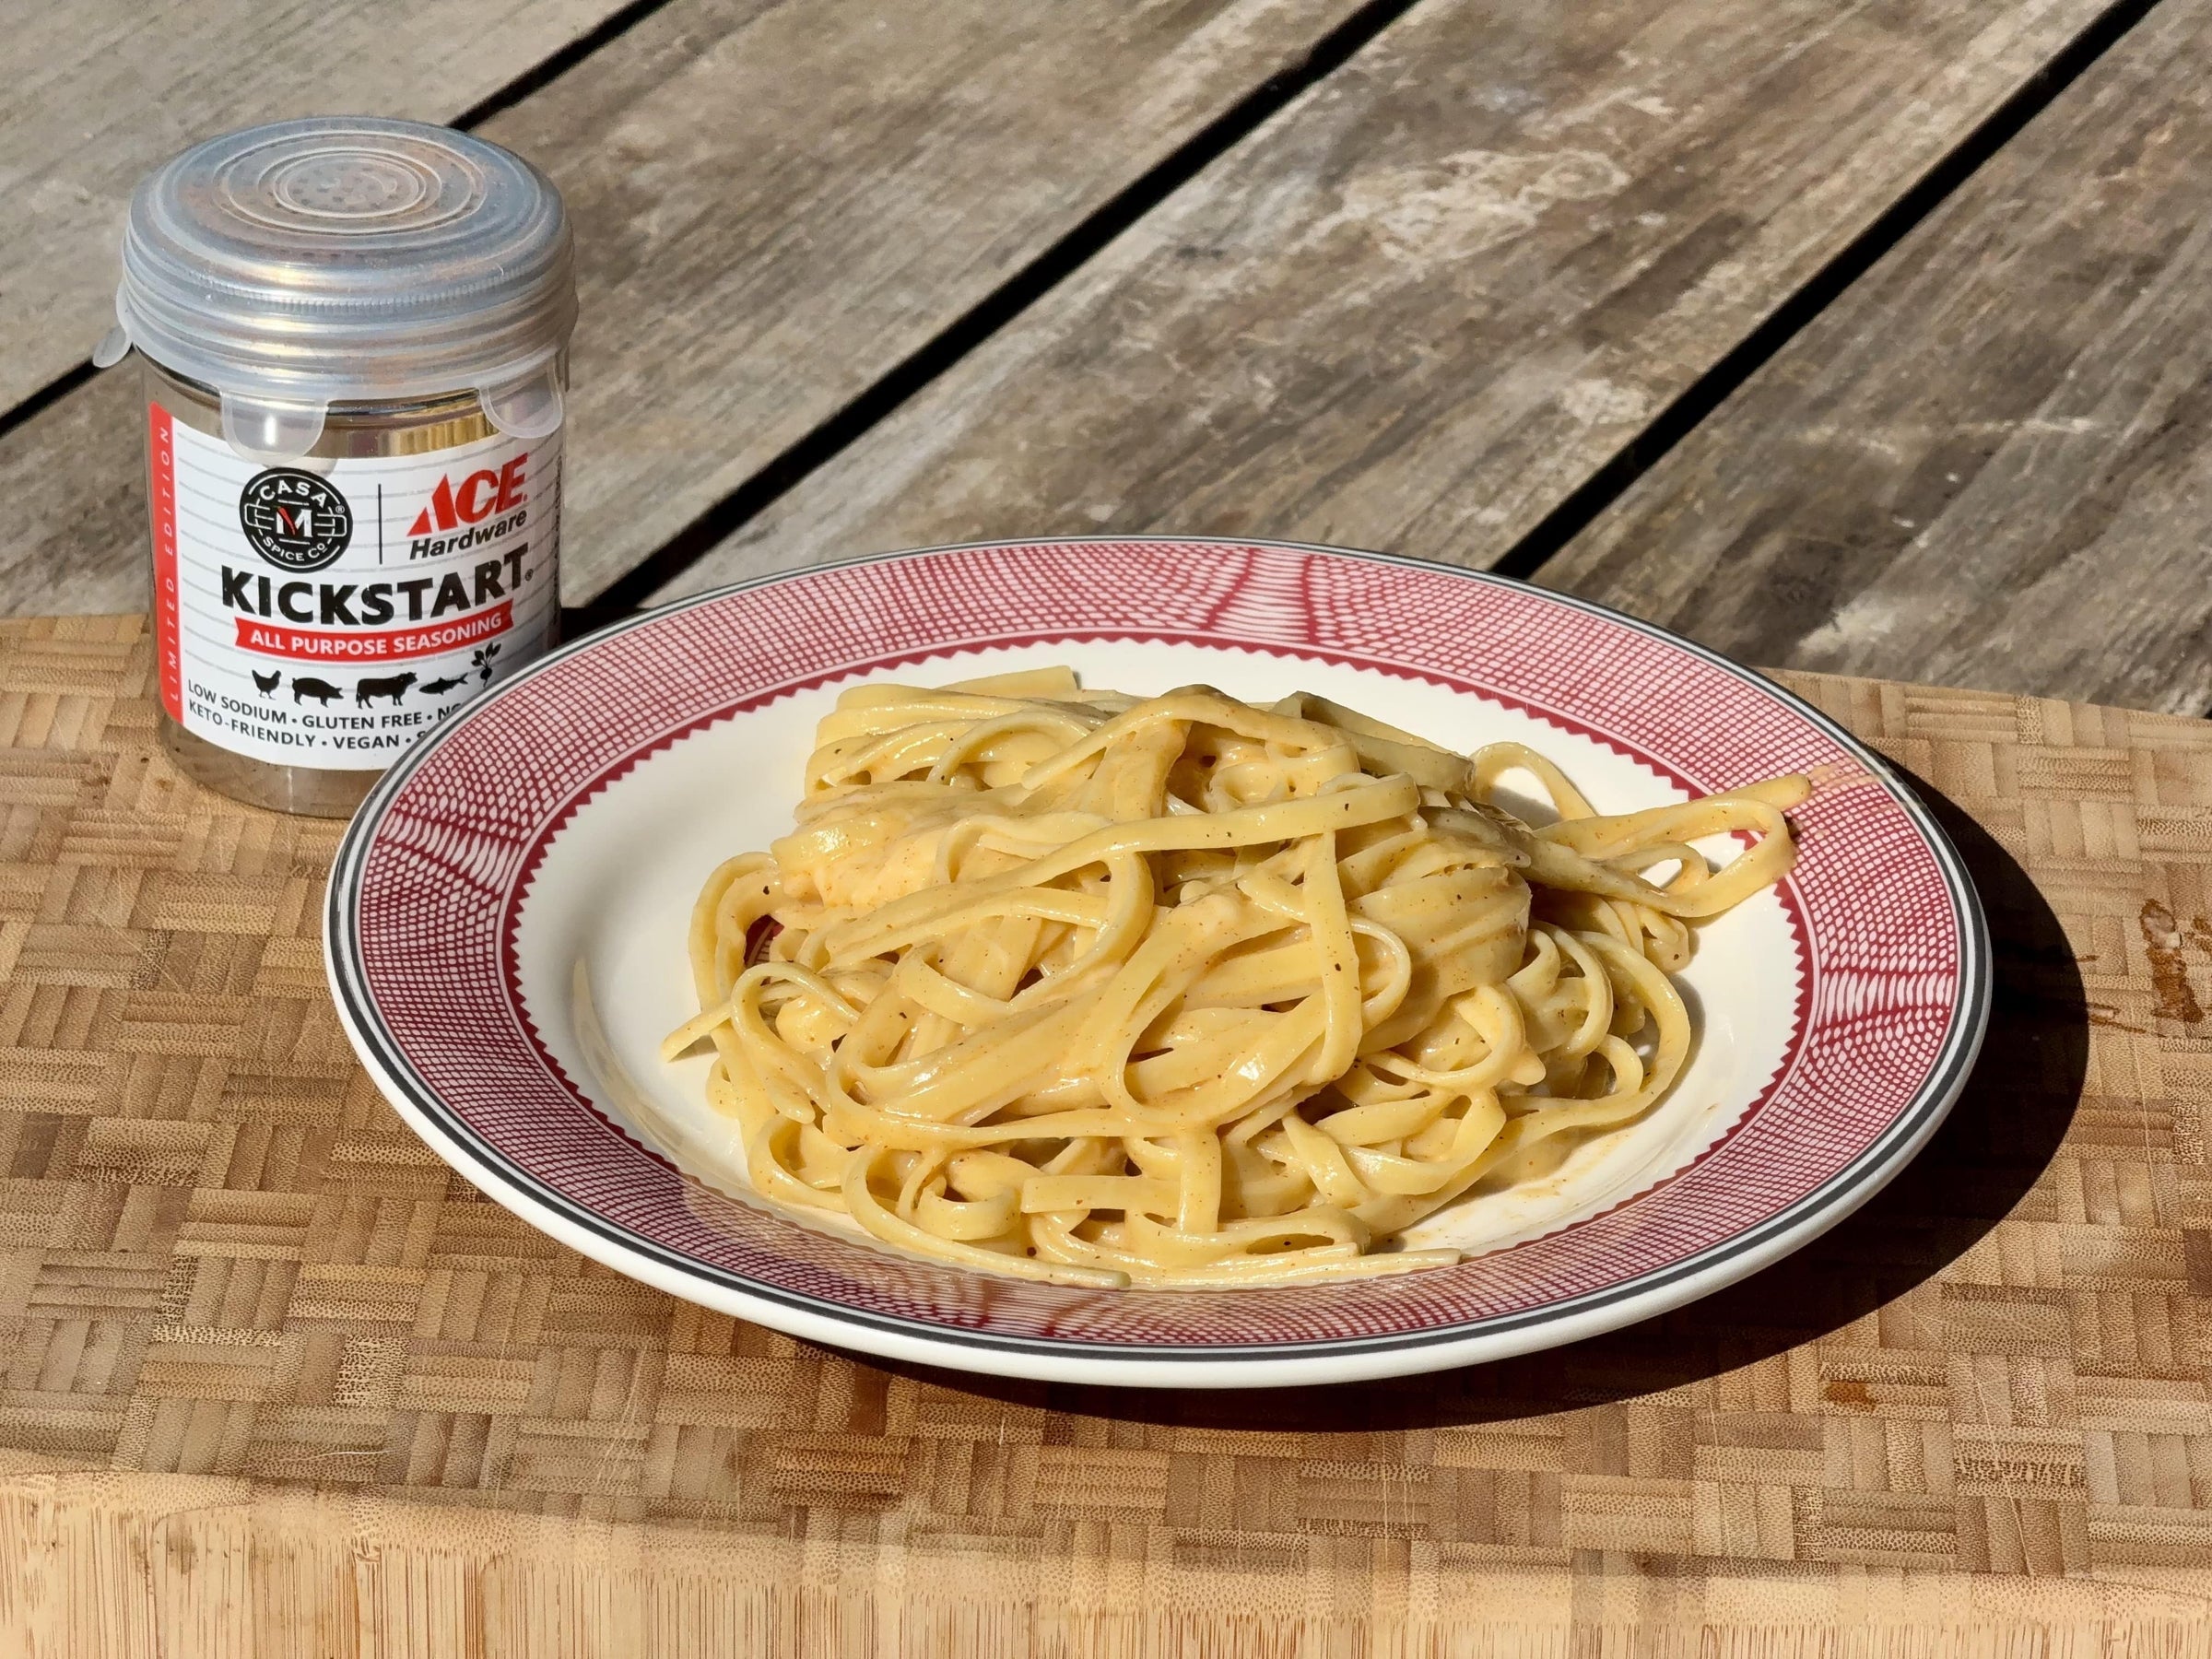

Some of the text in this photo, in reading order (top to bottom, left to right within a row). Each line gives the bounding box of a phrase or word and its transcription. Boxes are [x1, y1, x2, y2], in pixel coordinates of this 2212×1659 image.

[259, 479, 327, 509] CASA
[406, 452, 529, 536] ACE
[263, 535, 305, 561] SPICE
[409, 509, 527, 560] Hardware
[159, 427, 180, 702] LIMITED EDITION
[250, 610, 502, 655] ALL PURPOSE SEASONING
[188, 678, 218, 705] LOW
[220, 695, 288, 725] SODIUM
[302, 713, 376, 731] GLUTEN
[381, 711, 423, 728] FREE
[188, 698, 400, 749] KETO-FRIENDLY VEGAN
